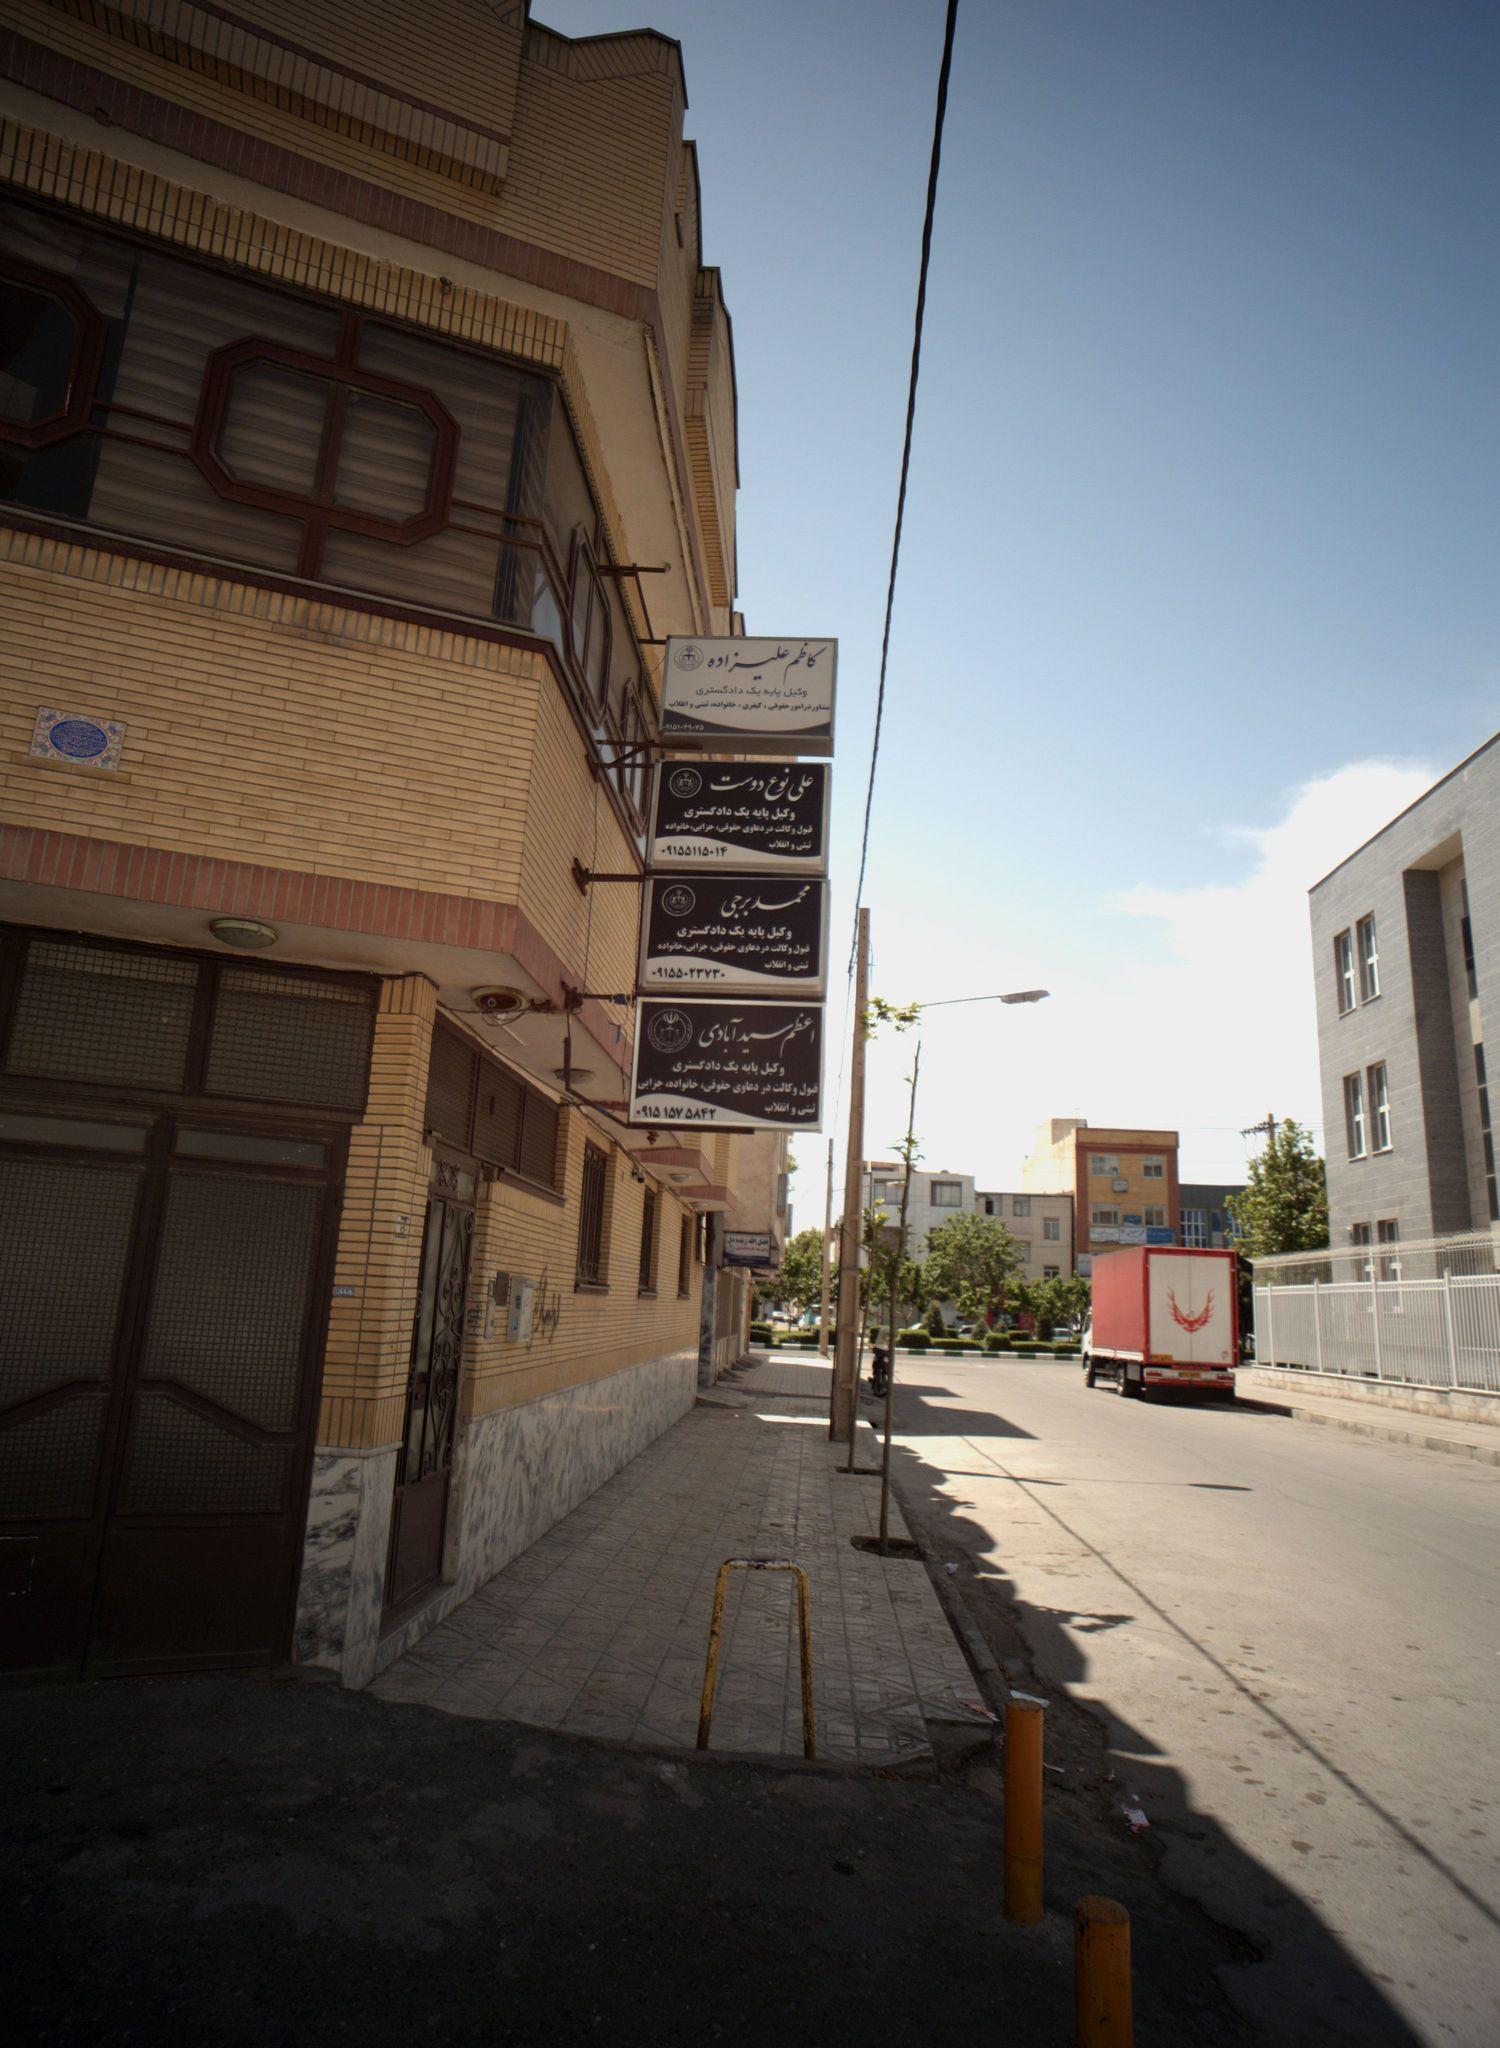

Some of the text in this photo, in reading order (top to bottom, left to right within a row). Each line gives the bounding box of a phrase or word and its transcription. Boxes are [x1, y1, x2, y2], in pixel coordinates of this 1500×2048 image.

[782, 642, 826, 684] کاظم
[695, 684, 808, 698] وکیل پایه یک دادگستری
[710, 767, 814, 802] علی نوع دوست
[684, 806, 796, 820] وکیل پایه یک دادگستری
[742, 824, 765, 833] دعاوی
[764, 826, 774, 834] در
[774, 825, 795, 834] وکالت
[796, 825, 813, 835] قبول
[768, 840, 790, 848] انقلاب
[796, 841, 812, 850] ثبتی
[661, 846, 728, 858] ۰۹۱۵۵۱۱۵۰۱۴
[720, 884, 810, 920] محمد برجی
[676, 925, 792, 940] وکیل پایه یک دادگستری
[737, 944, 760, 954] دعاوی
[760, 946, 770, 954] در
[770, 944, 792, 954] وکالت
[793, 945, 810, 955] قبول
[764, 960, 786, 969] انقلاب
[792, 961, 809, 971] ثبتی
[778, 1012, 816, 1060] اعظم
[672, 1060, 785, 1076] وکیل پایه یک دادگستری
[732, 1082, 759, 1093] دعاوی
[761, 1084, 771, 1094] در
[772, 1083, 798, 1096] وکالت
[798, 1085, 818, 1096] قبول
[636, 1105, 661, 1118] ۰۹۱۵
[664, 1106, 684, 1119] ۱۵۷
[764, 1102, 790, 1112] انقلاب
[797, 1104, 816, 1116] ثبتی
